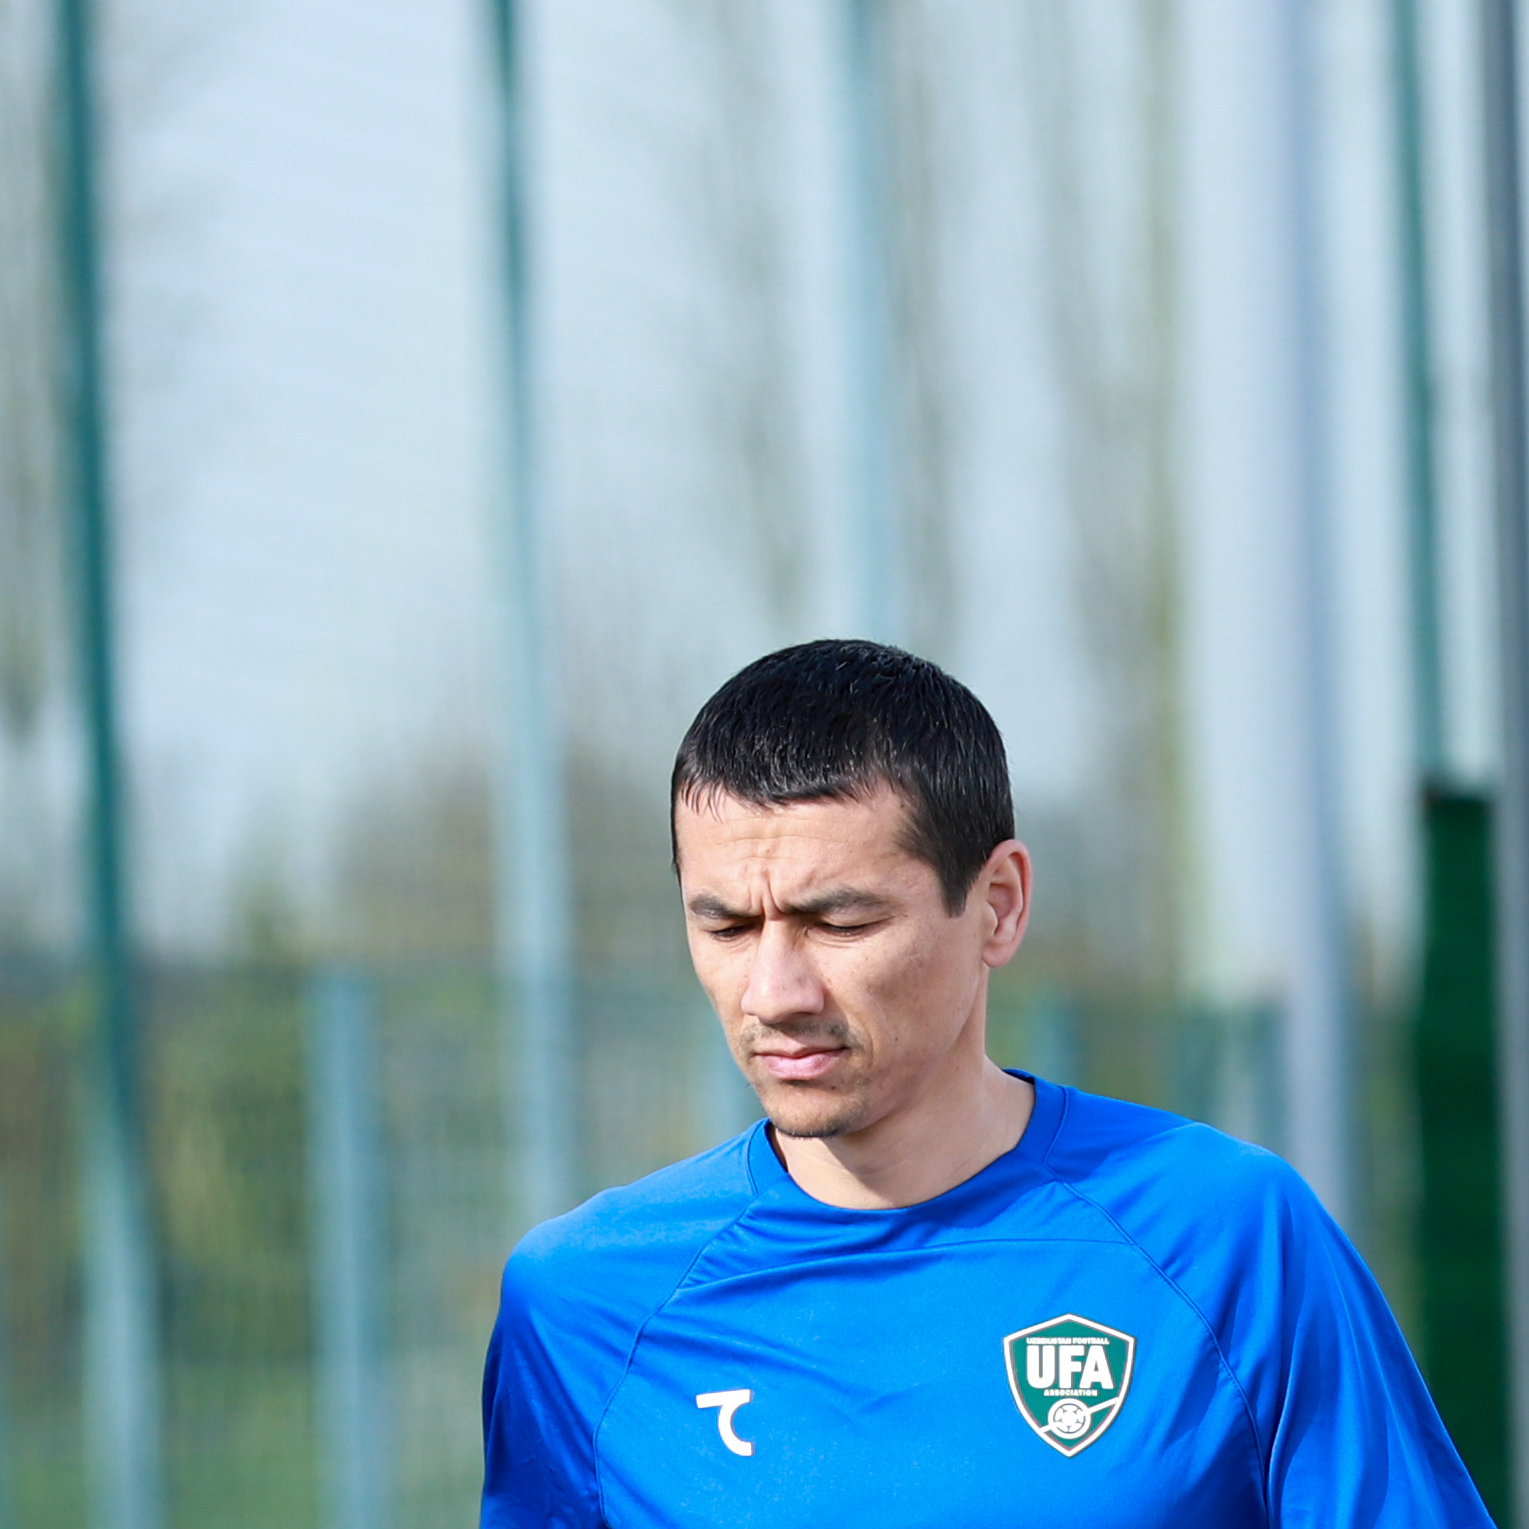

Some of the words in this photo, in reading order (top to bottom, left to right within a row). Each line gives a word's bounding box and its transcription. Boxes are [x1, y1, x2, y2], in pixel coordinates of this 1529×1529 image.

[1072, 1337, 1110, 1346] FOOTBALL
[1026, 1345, 1114, 1390] UFA
[1043, 1389, 1098, 1397] ASSOCIATION
